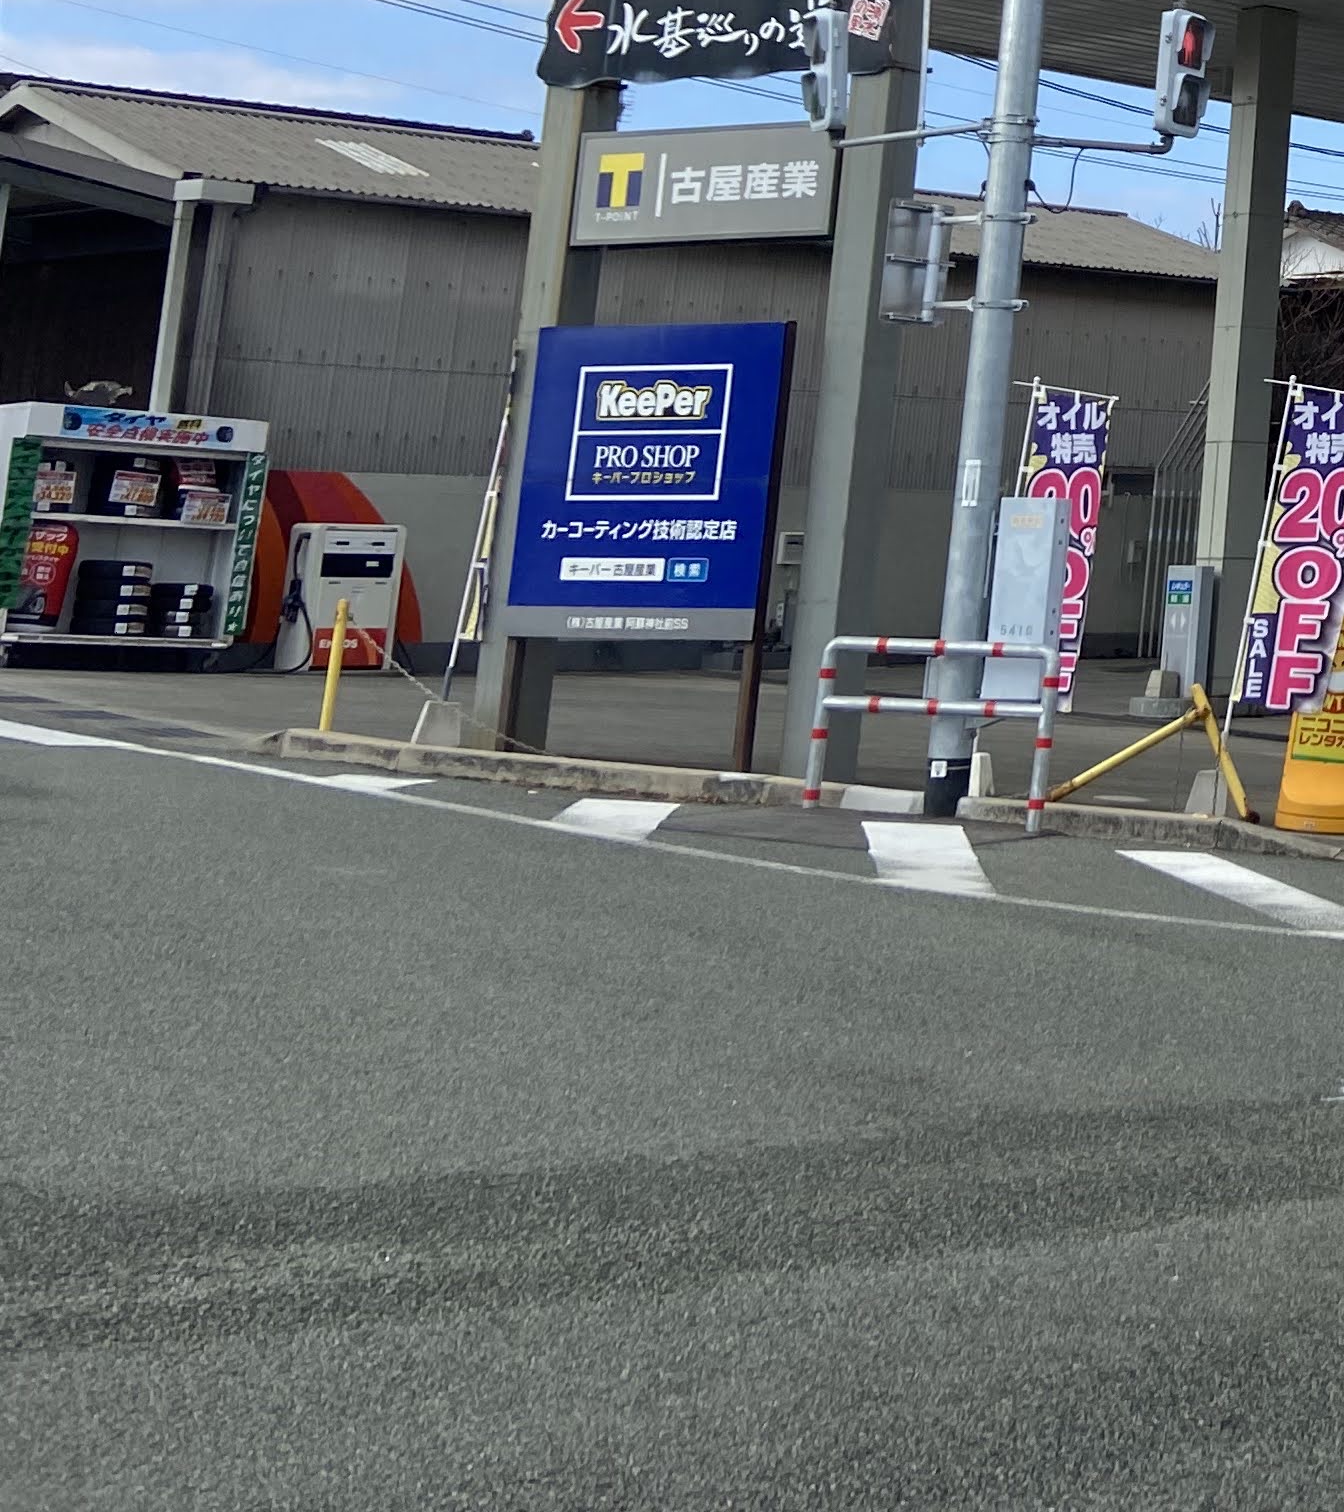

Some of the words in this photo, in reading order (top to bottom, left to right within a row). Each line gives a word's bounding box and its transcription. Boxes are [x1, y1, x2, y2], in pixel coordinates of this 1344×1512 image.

[670, 159, 820, 204] 古屋産業
[596, 380, 711, 420] KeePer
[1037, 400, 1106, 430] オイル
[104, 412, 167, 426] タイヤ
[594, 445, 638, 469] PRO
[641, 444, 700, 468] SHOP
[1051, 433, 1098, 464] 特売
[592, 471, 696, 485] キーパープロショップ
[541, 519, 737, 541] カーコーティング技術認定店
[1243, 618, 1269, 699] SALE
